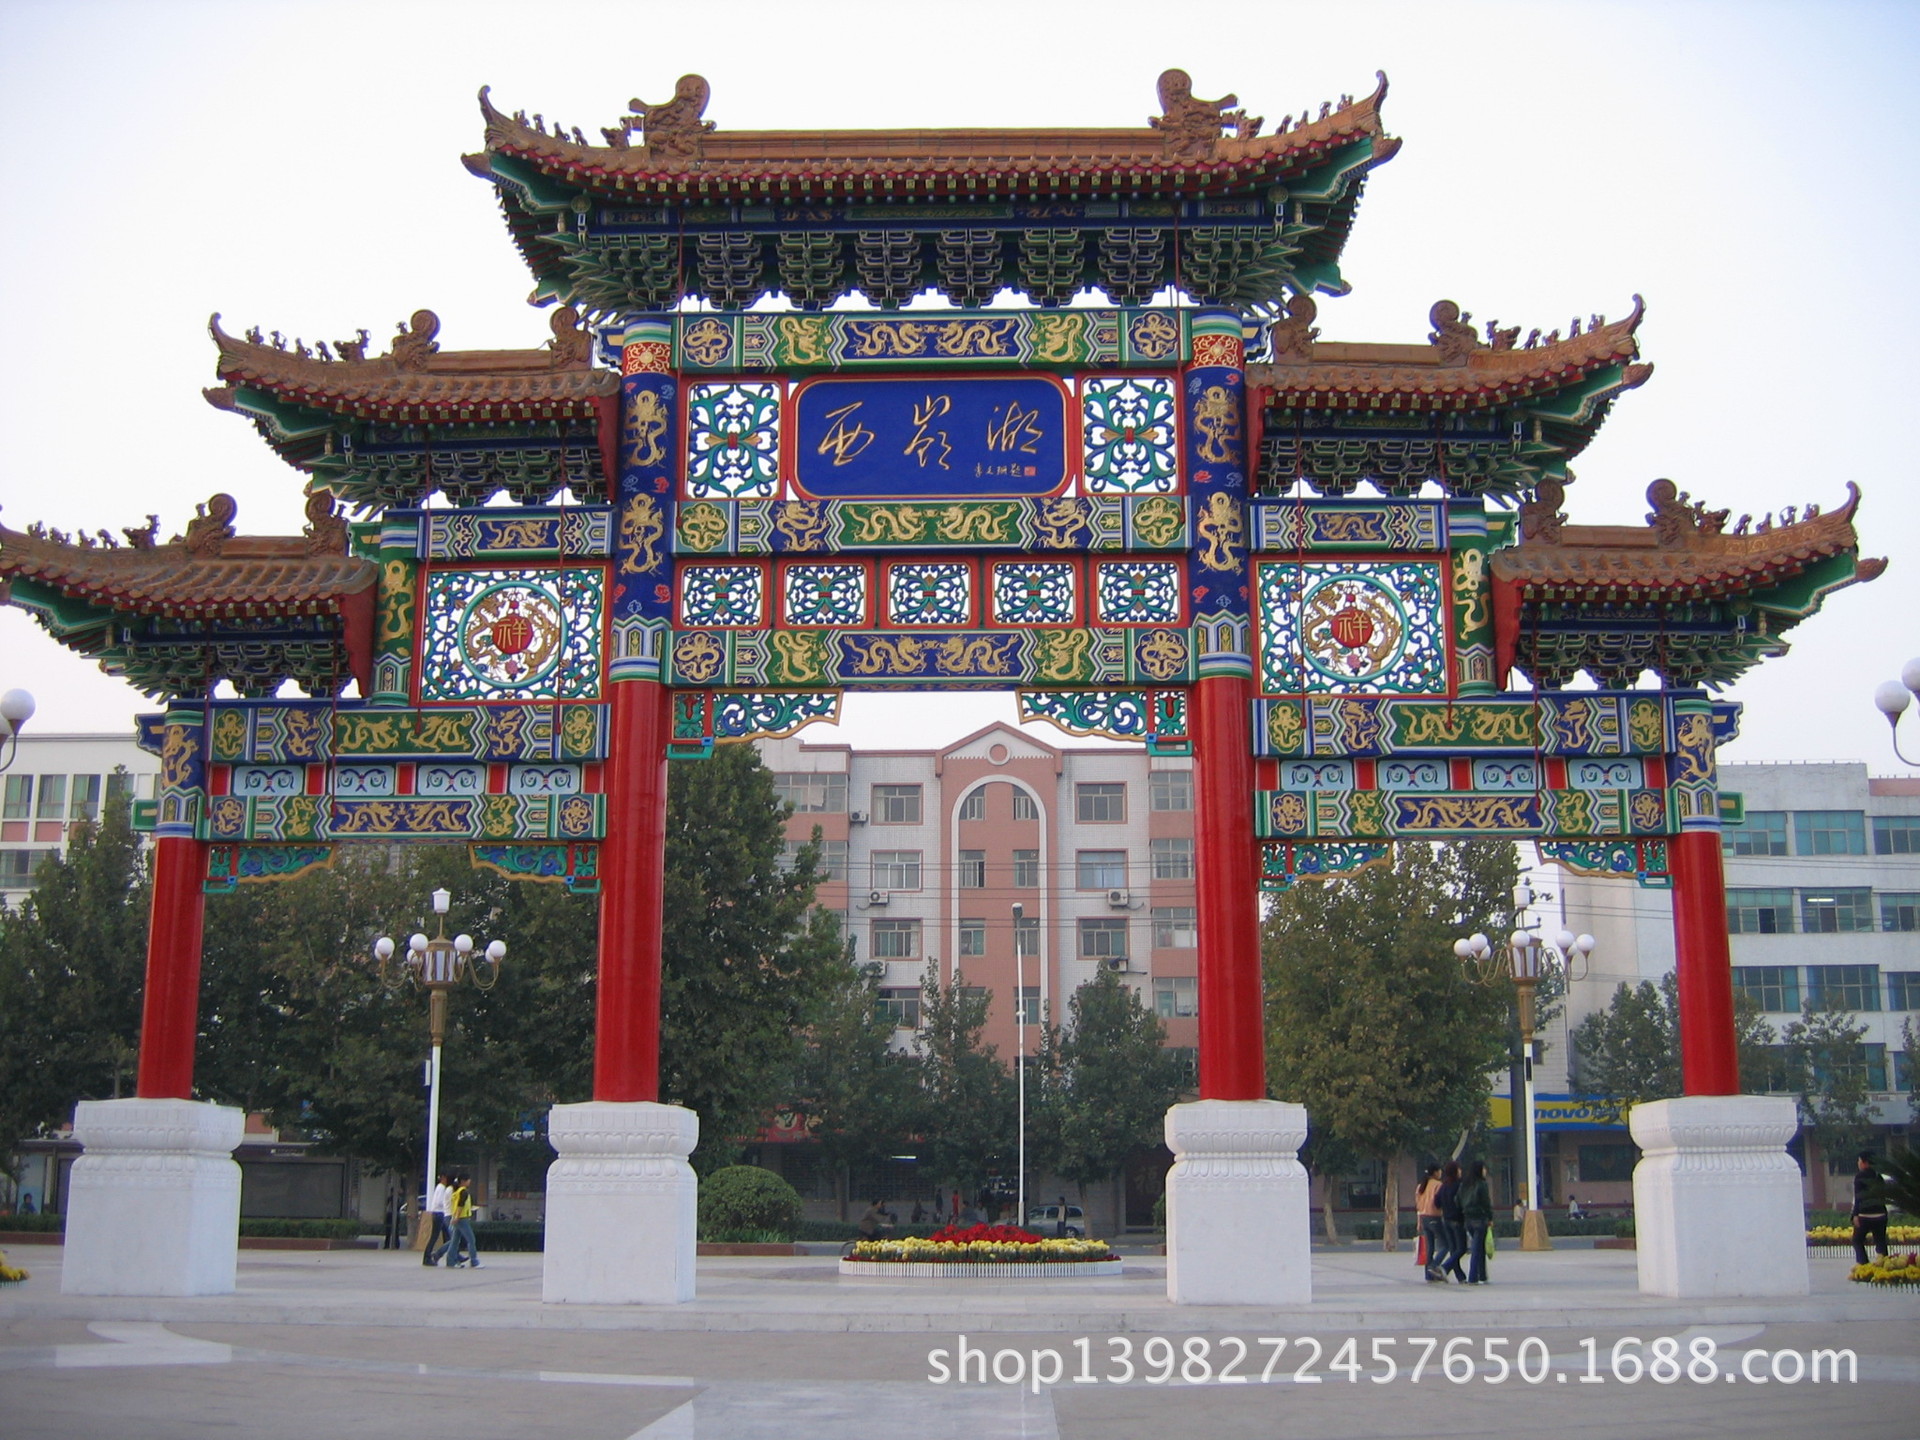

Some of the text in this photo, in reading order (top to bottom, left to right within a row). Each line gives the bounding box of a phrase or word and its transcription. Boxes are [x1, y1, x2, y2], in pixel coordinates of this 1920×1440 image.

[497, 618, 528, 649] 祥
[1338, 611, 1369, 643] 祥
[1535, 1108, 1590, 1119] novo
